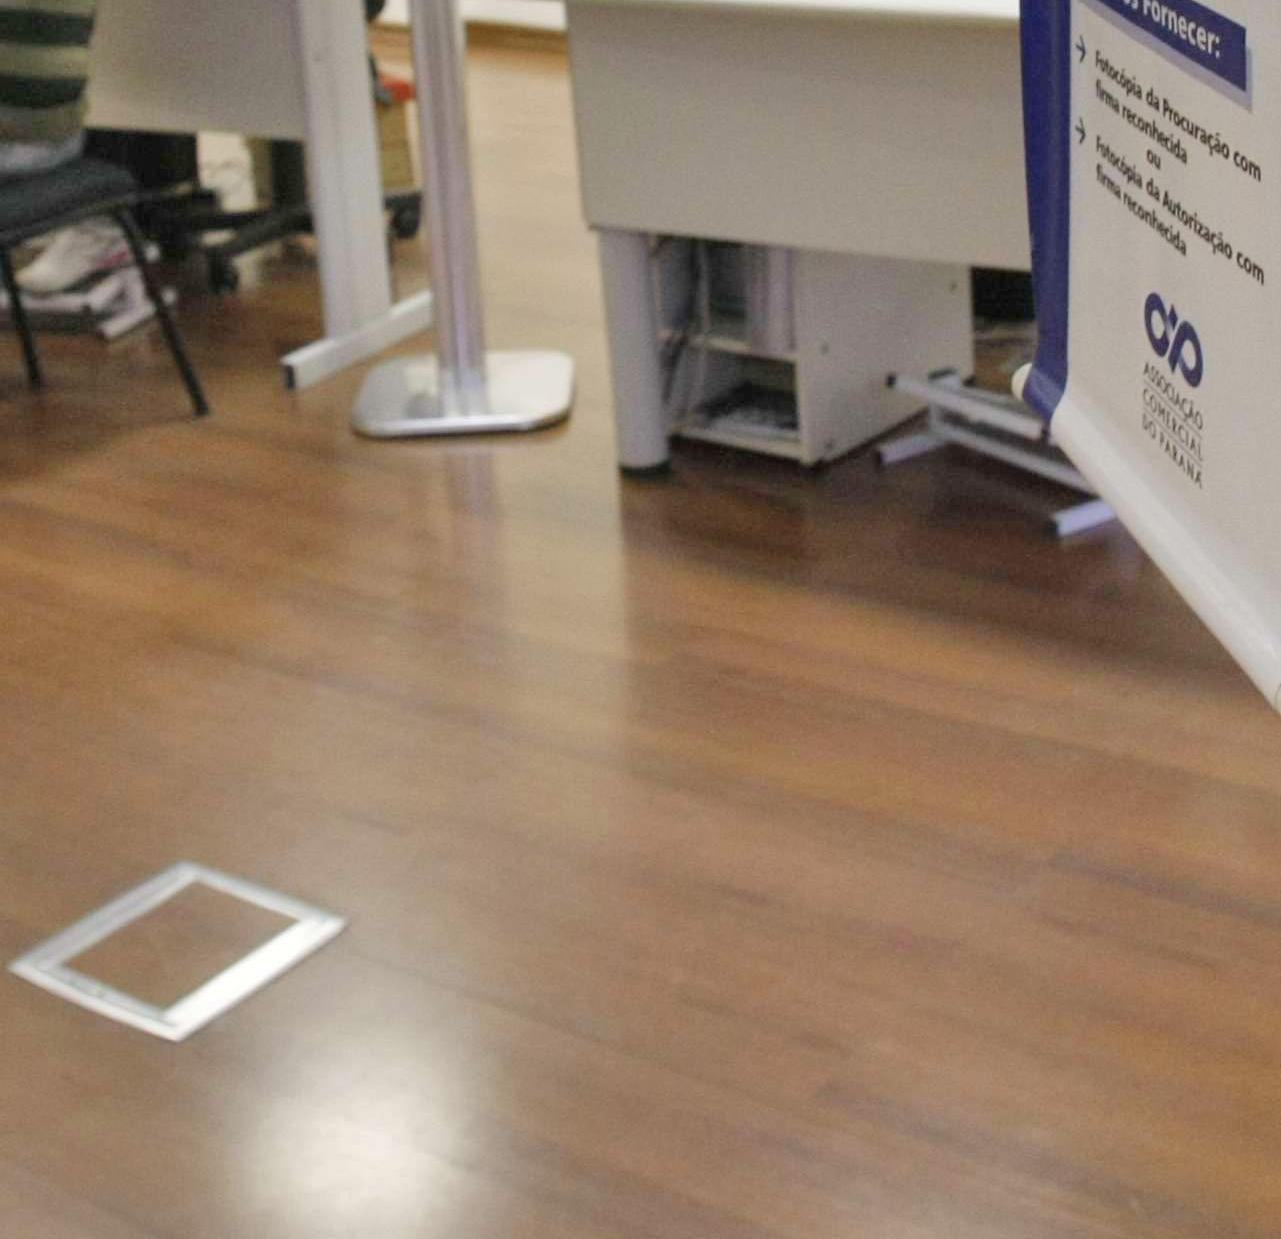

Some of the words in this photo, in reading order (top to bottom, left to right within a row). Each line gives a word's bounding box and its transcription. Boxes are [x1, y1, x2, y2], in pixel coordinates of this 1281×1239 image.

[1095, 50, 1143, 101] Fotocópia
[1146, 88, 1160, 111] da
[1163, 98, 1230, 160] Procuração
[1233, 152, 1262, 182] com
[1096, 79, 1120, 115] firma
[1122, 105, 1188, 165] reconhecida
[1147, 149, 1161, 170] ou
[1096, 135, 1143, 189] Fotocópia
[1146, 177, 1160, 201] da
[1163, 191, 1232, 260] Autorização
[1236, 252, 1265, 286] com
[1096, 164, 1120, 201] firma
[1123, 193, 1187, 257] reconhecida
[1143, 362, 1203, 430] ASSOCIAÇÃO
[1143, 388, 1202, 461] COMERCIAL
[1143, 413, 1156, 439] DO
